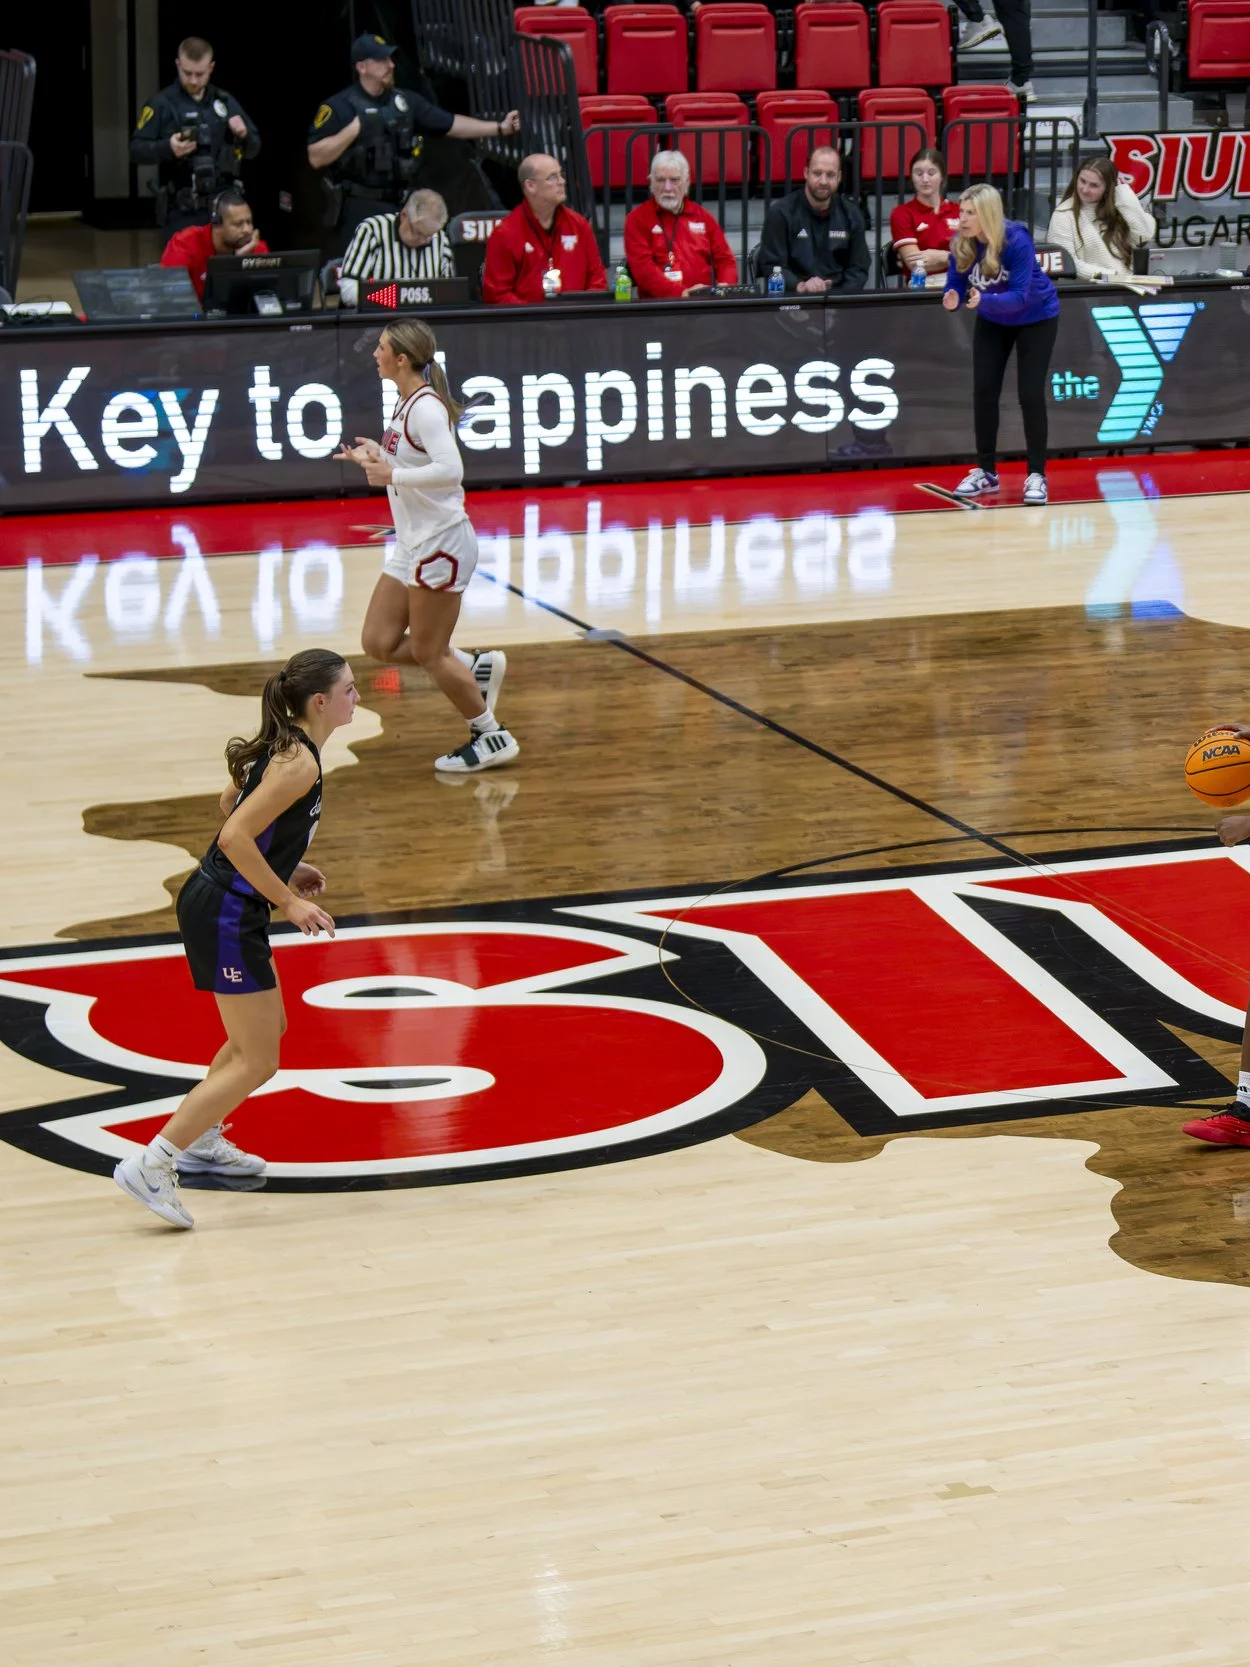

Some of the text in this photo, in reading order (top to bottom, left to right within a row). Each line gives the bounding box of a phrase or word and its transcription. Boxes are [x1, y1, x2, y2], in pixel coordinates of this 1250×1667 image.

[400, 287, 433, 306] POSS.
[1051, 371, 1100, 401] the
[19, 341, 900, 495] Key to appiness
[1202, 745, 1241, 762] NCAA
[222, 967, 243, 983] UE
